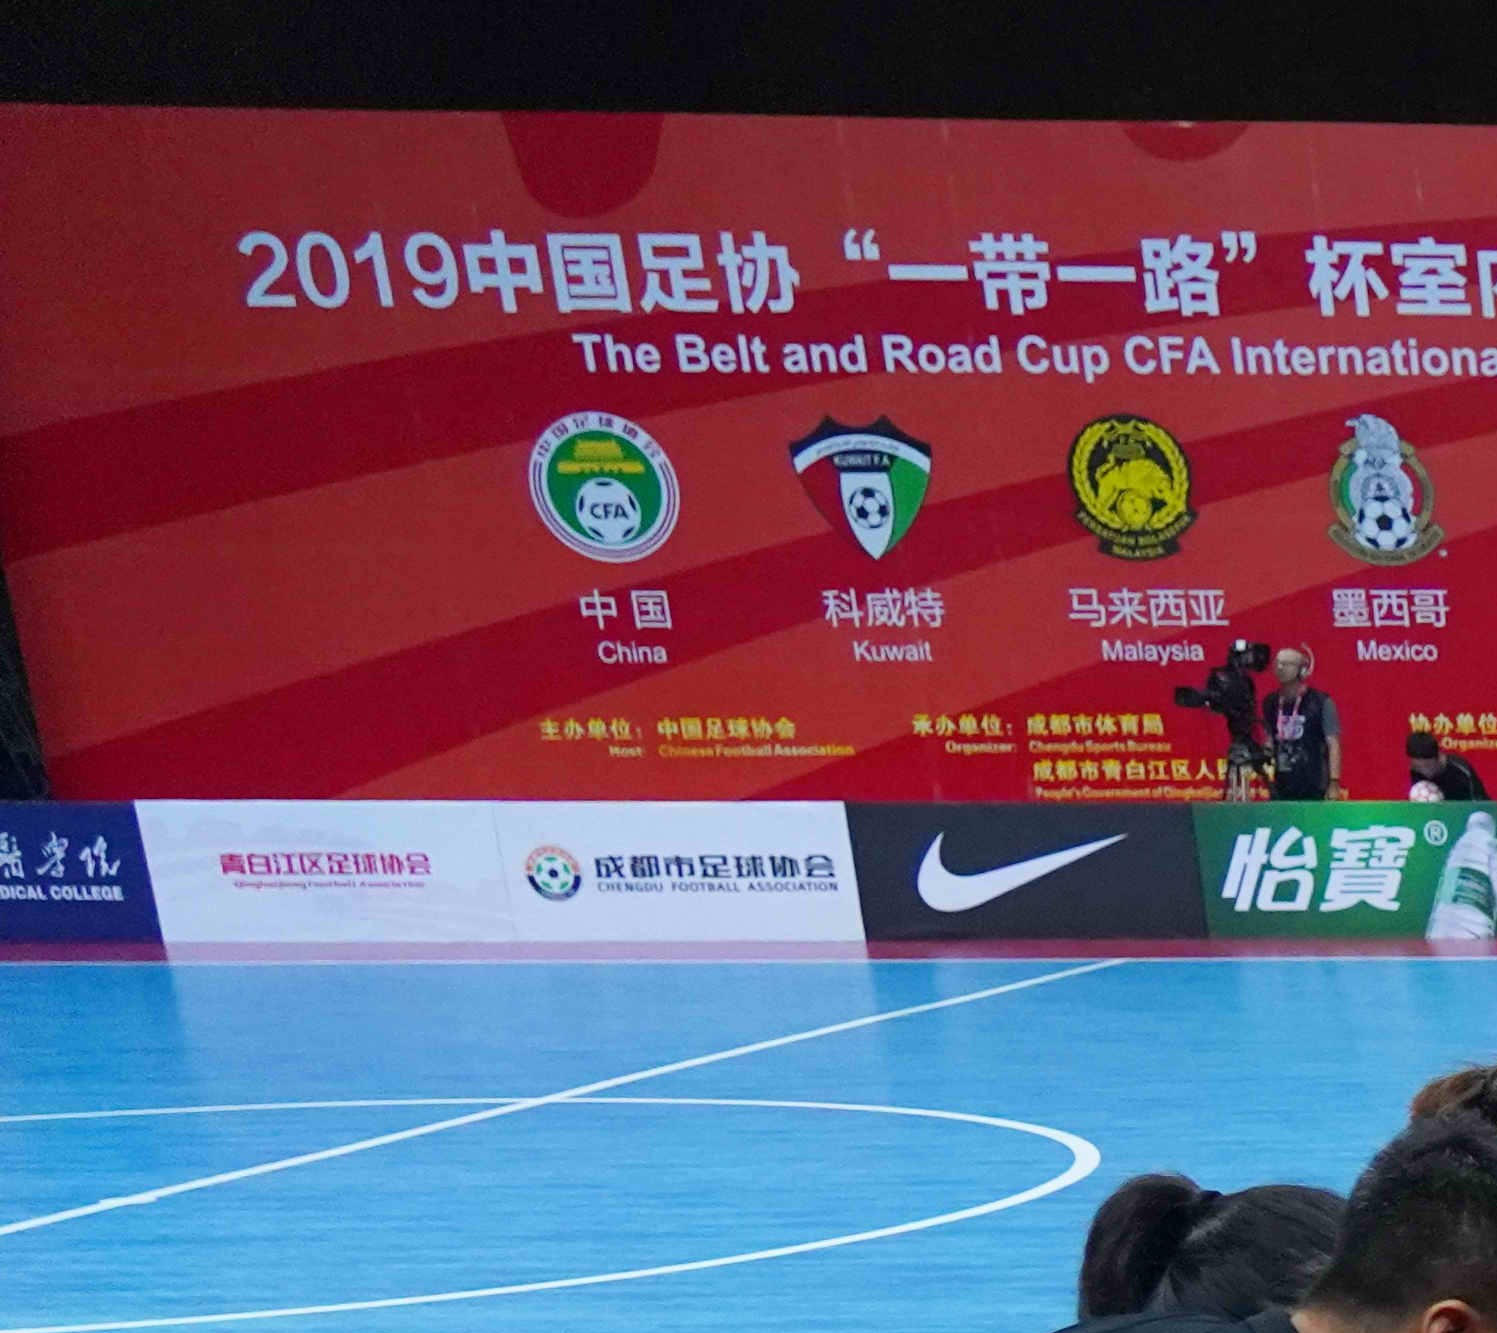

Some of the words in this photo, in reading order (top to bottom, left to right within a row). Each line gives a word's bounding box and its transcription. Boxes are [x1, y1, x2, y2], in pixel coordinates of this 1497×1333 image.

[573, 332, 661, 374] The
[676, 333, 770, 374] Belt
[783, 334, 868, 374] and
[881, 335, 1001, 375] Road
[1017, 335, 1110, 384] Cup
[1123, 336, 1220, 376] CFA
[589, 502, 630, 520] CFA
[579, 589, 673, 630] 中国
[822, 588, 945, 629] 科威特
[1068, 587, 1230, 628] 马来西亚
[1332, 588, 1450, 628] 墨西哥
[597, 640, 668, 663] China
[853, 640, 934, 662] Kuwait
[1102, 639, 1204, 667] Malaysia
[1357, 639, 1439, 662] Mexico
[657, 716, 796, 740] 中国足球协会
[1026, 713, 1165, 736] 成都市体育局
[219, 851, 432, 877] 青白江区足球协会
[593, 853, 837, 879] 成都市足球协会
[49, 885, 125, 902] COLLEGE
[598, 881, 664, 894] CHENGDU
[671, 881, 741, 894] FOOTBALL
[747, 881, 840, 894] ASSOCIATION
